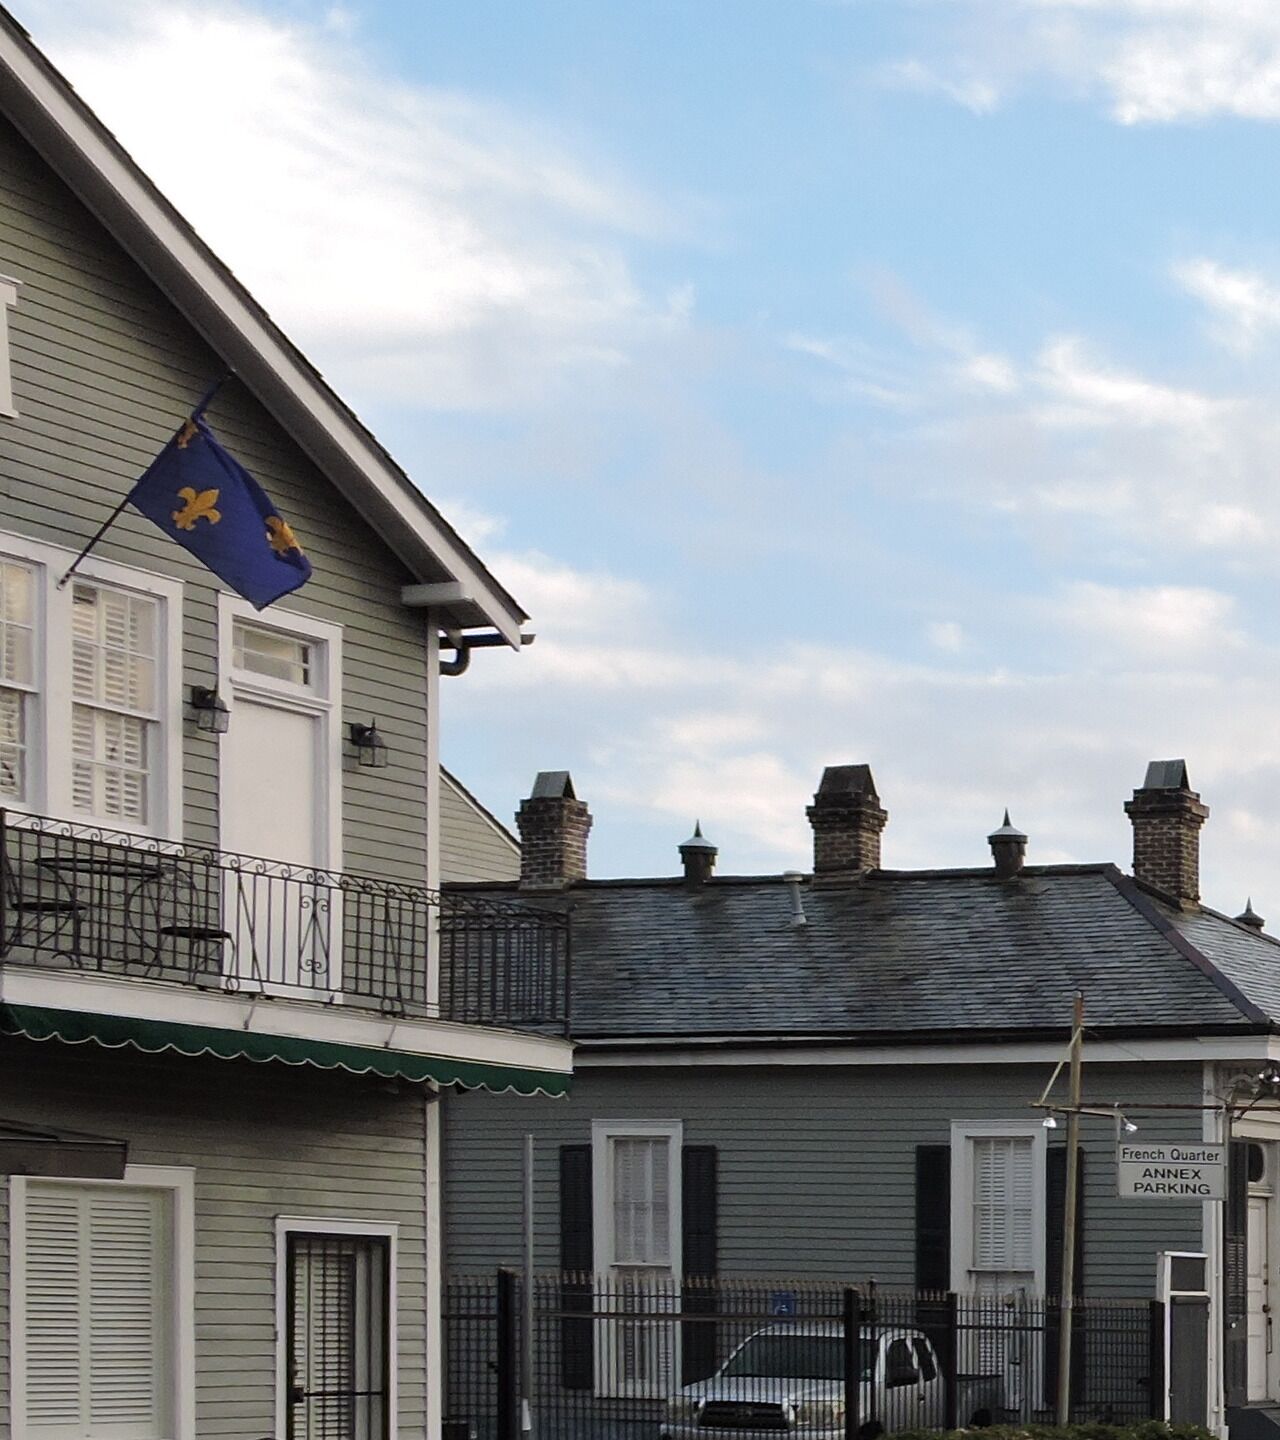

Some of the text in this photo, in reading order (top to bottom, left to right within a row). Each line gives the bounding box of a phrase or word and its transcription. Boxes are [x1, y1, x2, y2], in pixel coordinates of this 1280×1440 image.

[1122, 1147, 1220, 1162] French Quarter
[1142, 1167, 1202, 1180] ANNEX
[1133, 1182, 1211, 1195] PARKING
